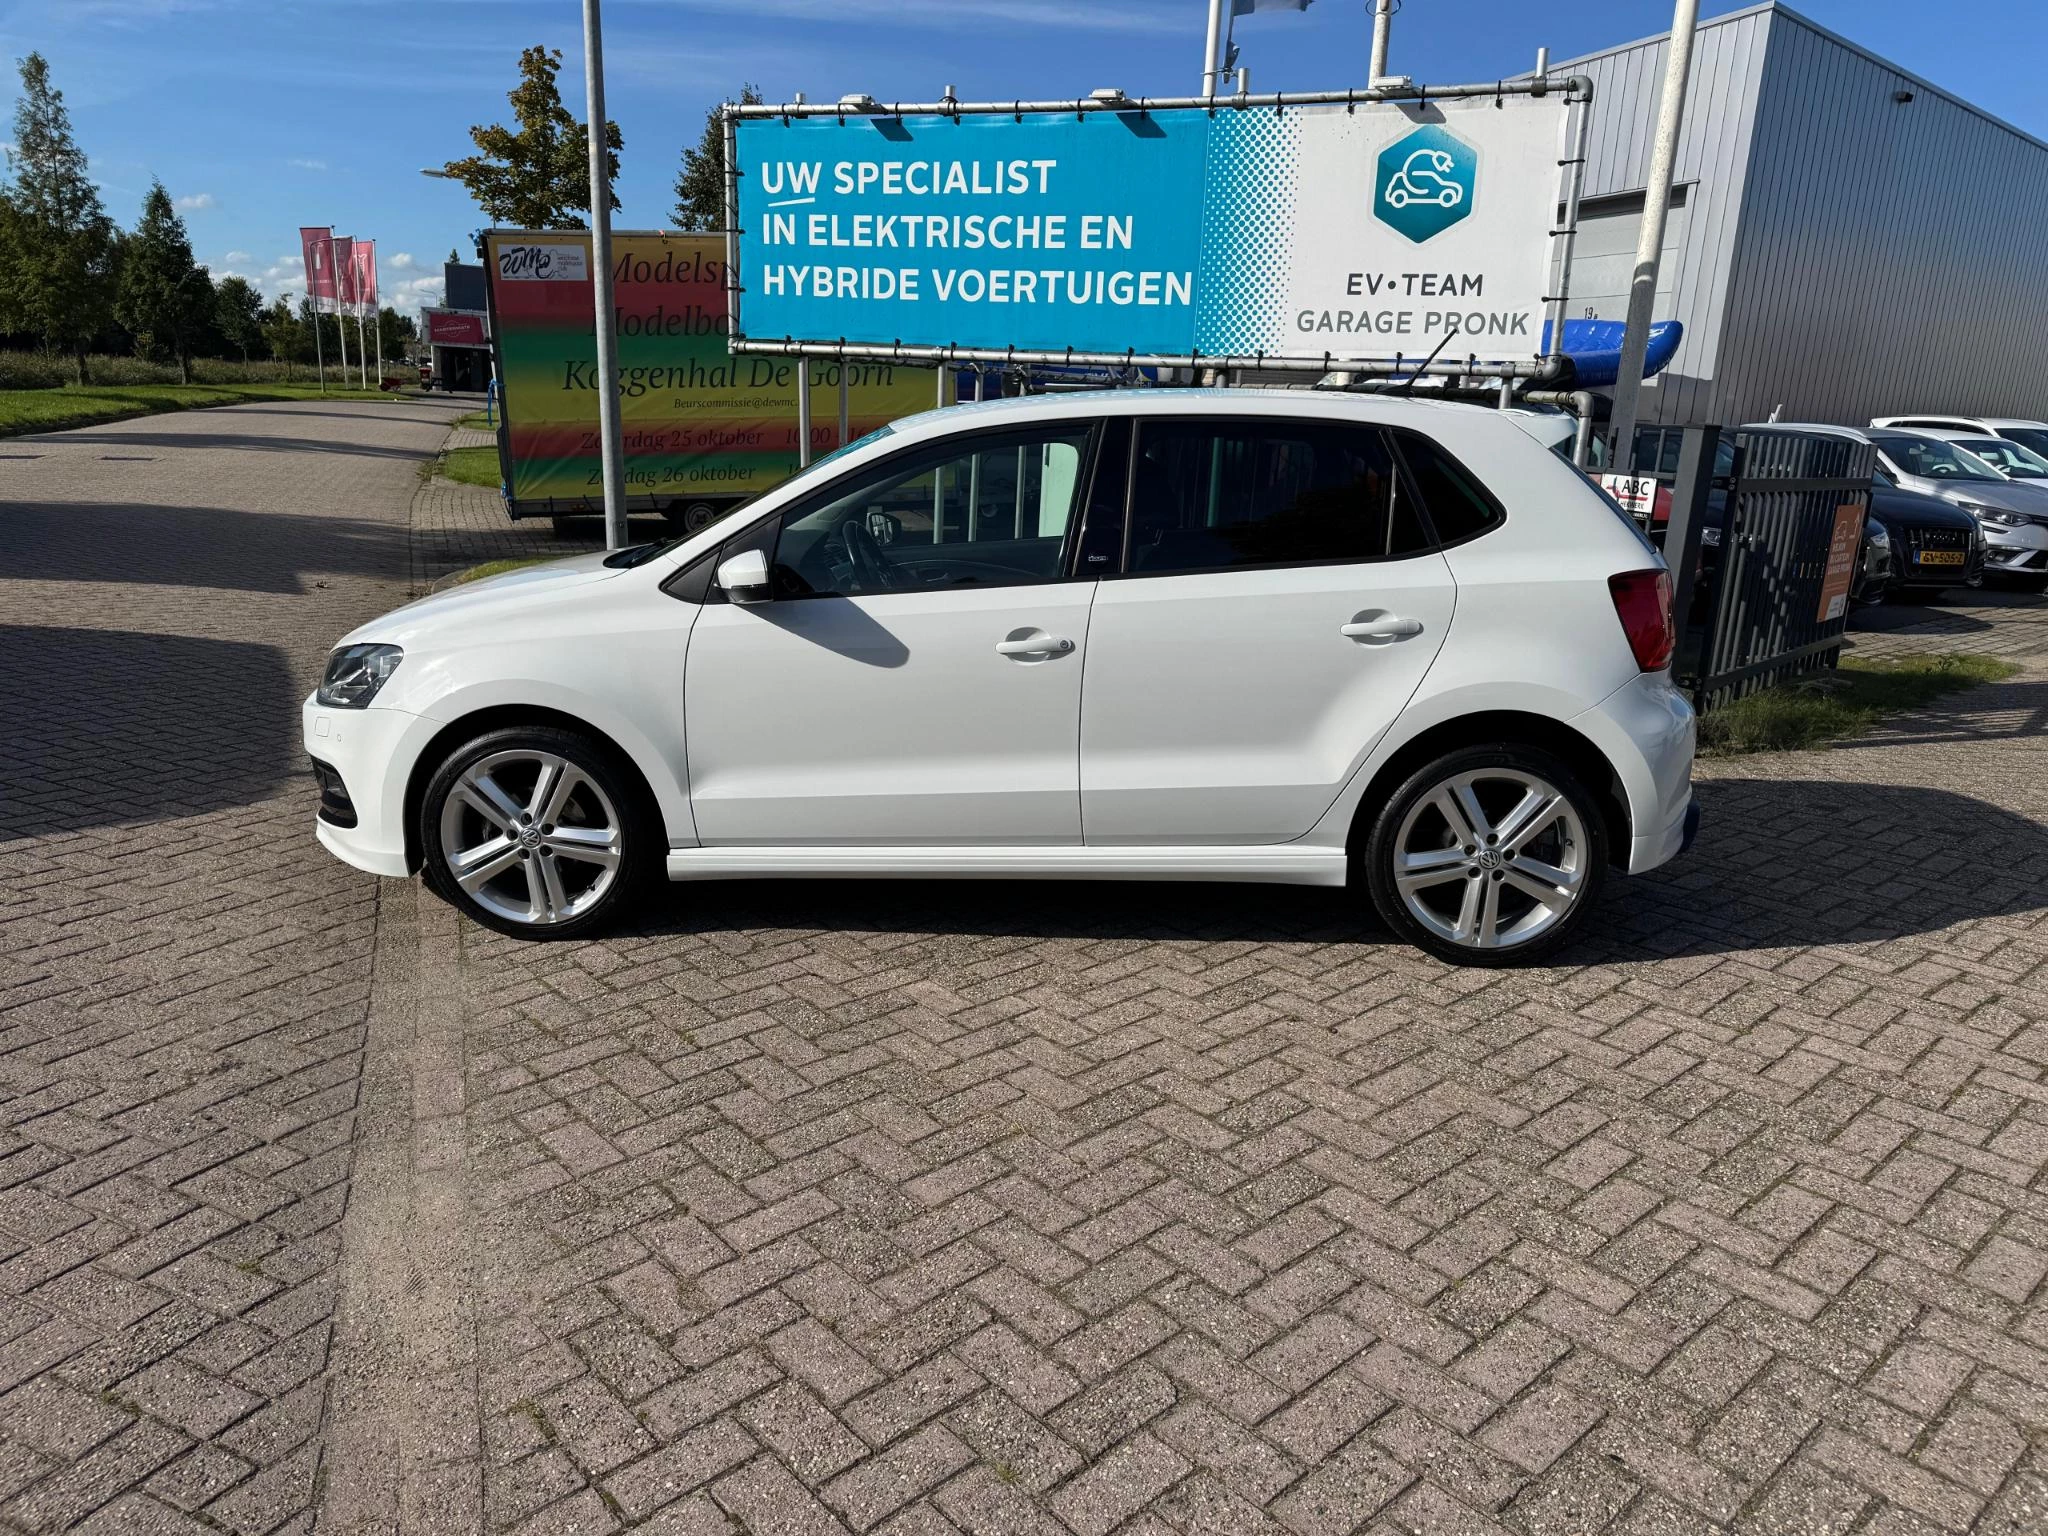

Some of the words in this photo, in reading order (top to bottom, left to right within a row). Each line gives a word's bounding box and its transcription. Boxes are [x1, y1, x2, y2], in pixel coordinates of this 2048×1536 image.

[762, 162, 821, 194] UW
[834, 160, 1057, 195] SPECIALIST
[762, 213, 796, 245] IN
[807, 214, 1067, 249] ELEKTRISCHE
[1080, 215, 1134, 249] EN
[764, 265, 919, 301] HYBRIDE
[932, 269, 1193, 306] VOERTUIGEN
[1296, 310, 1412, 335] GARAGE
[1424, 311, 1529, 335] PRONK
[749, 361, 790, 388] De
[671, 430, 691, 447] 25
[697, 426, 764, 446] oktober
[662, 466, 684, 483] 26
[690, 463, 756, 482] oktober
[1621, 479, 1650, 496] ABC
